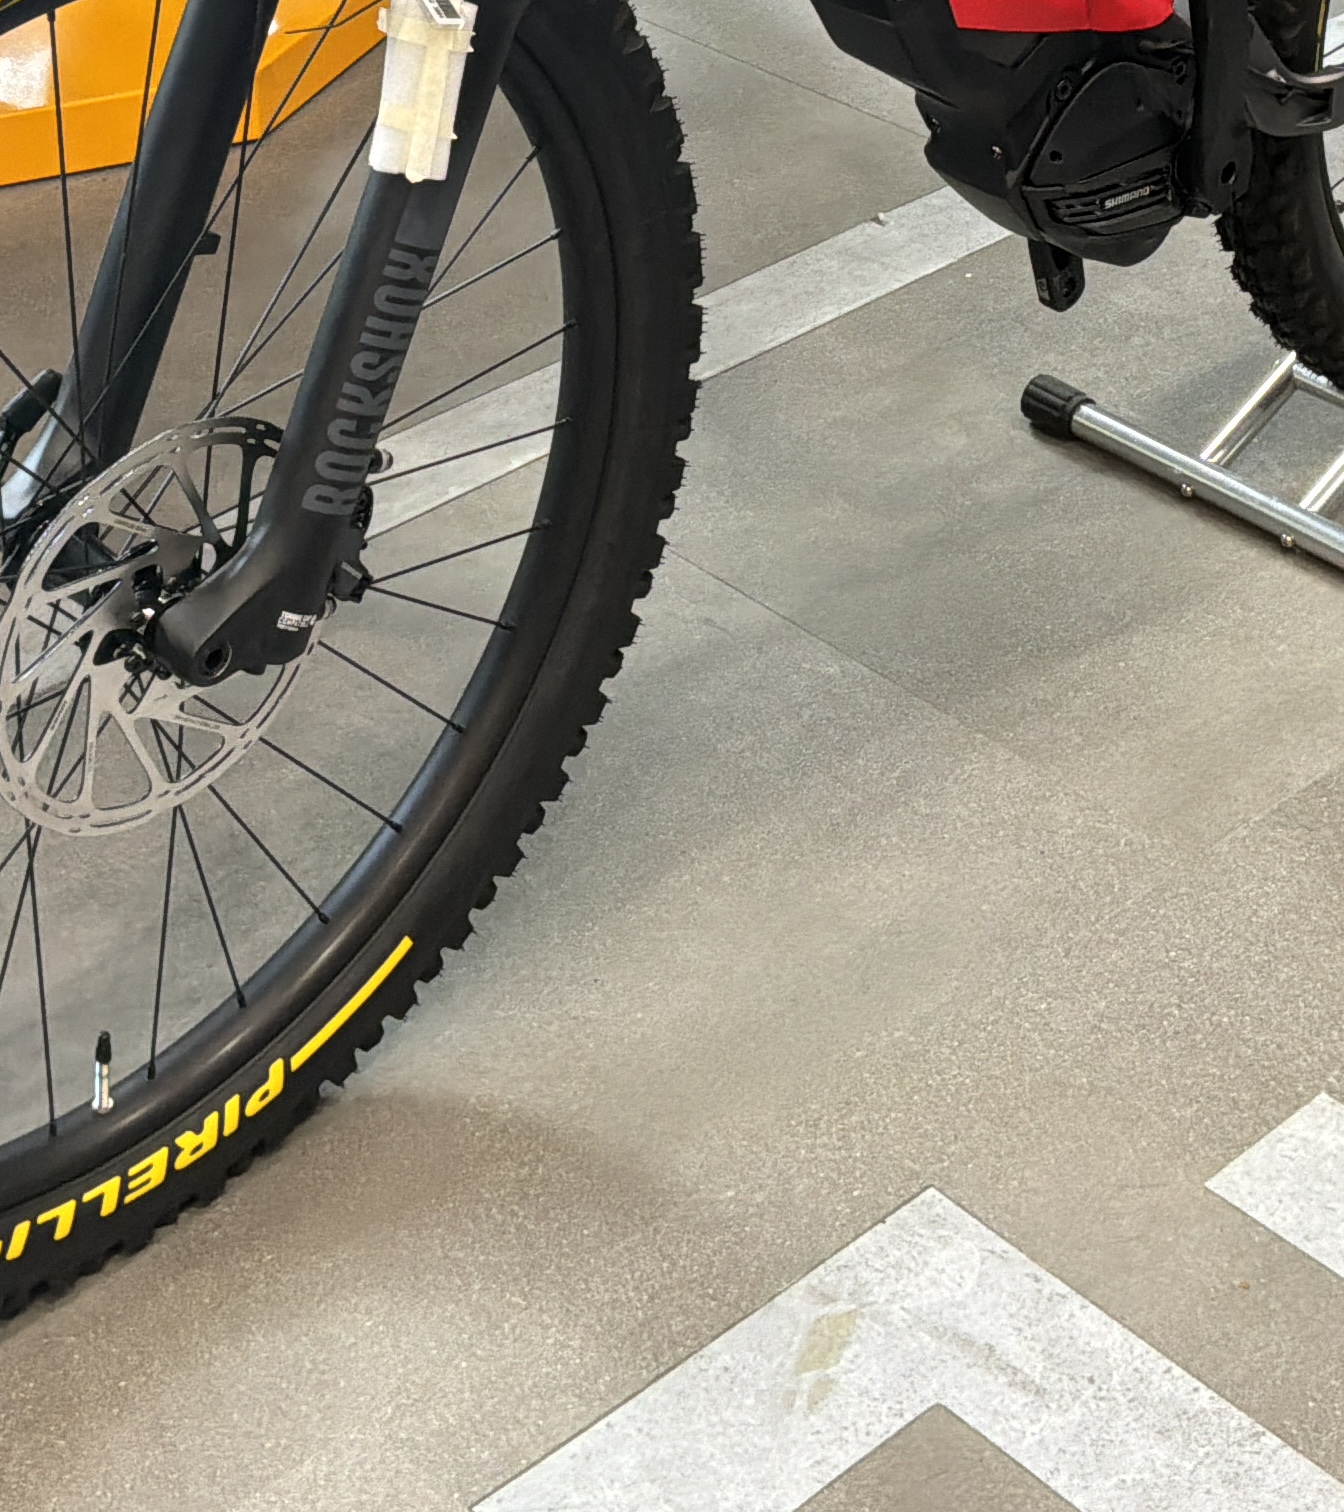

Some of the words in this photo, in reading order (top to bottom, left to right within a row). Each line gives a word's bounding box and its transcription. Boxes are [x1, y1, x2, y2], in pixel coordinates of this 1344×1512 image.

[1104, 185, 1151, 210] SHIMANO
[301, 247, 440, 517] ROCKSHOX
[5, 1057, 285, 1262] PIRELLI
